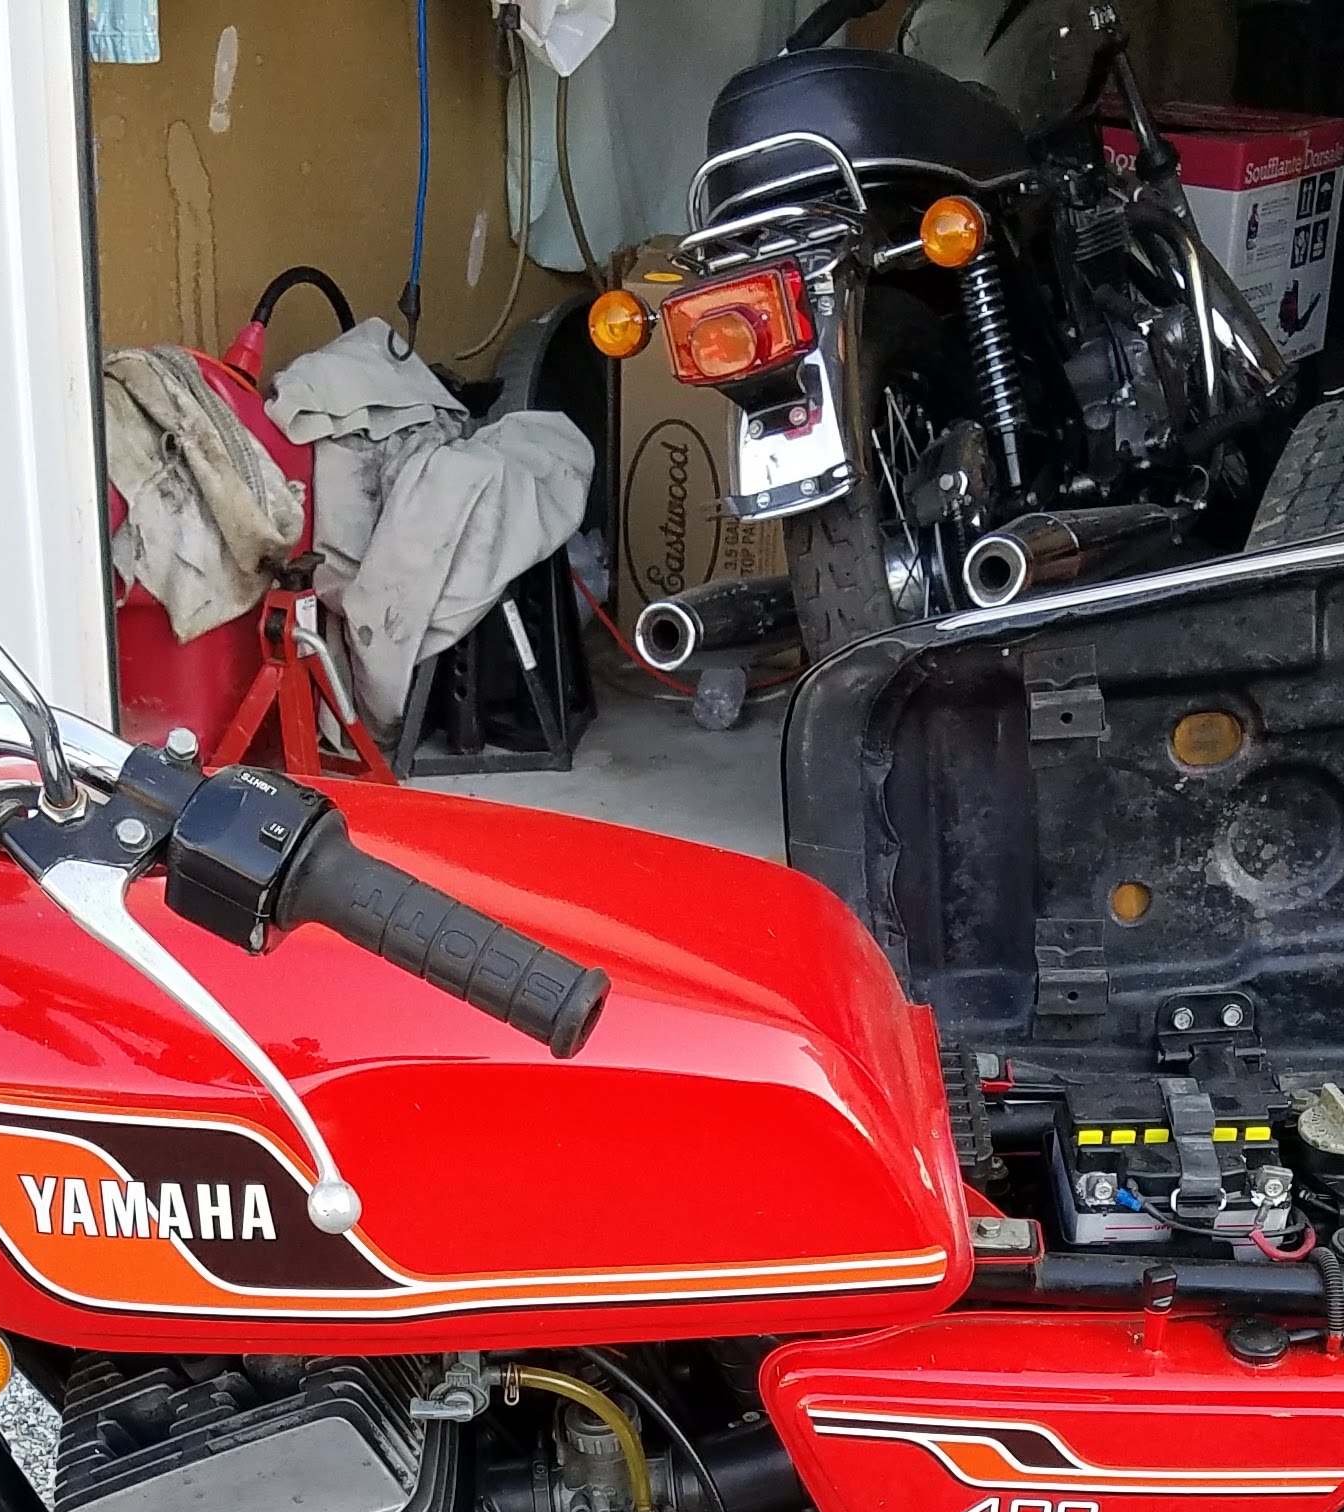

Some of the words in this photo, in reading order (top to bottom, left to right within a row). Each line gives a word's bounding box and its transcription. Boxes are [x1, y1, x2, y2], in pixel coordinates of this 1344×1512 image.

[647, 440, 690, 597] Eastwood
[240, 772, 278, 796] LIGHTS
[269, 823, 285, 835] HI
[351, 887, 565, 1004] SCOTT
[19, 1174, 277, 1242] YAMAHA
